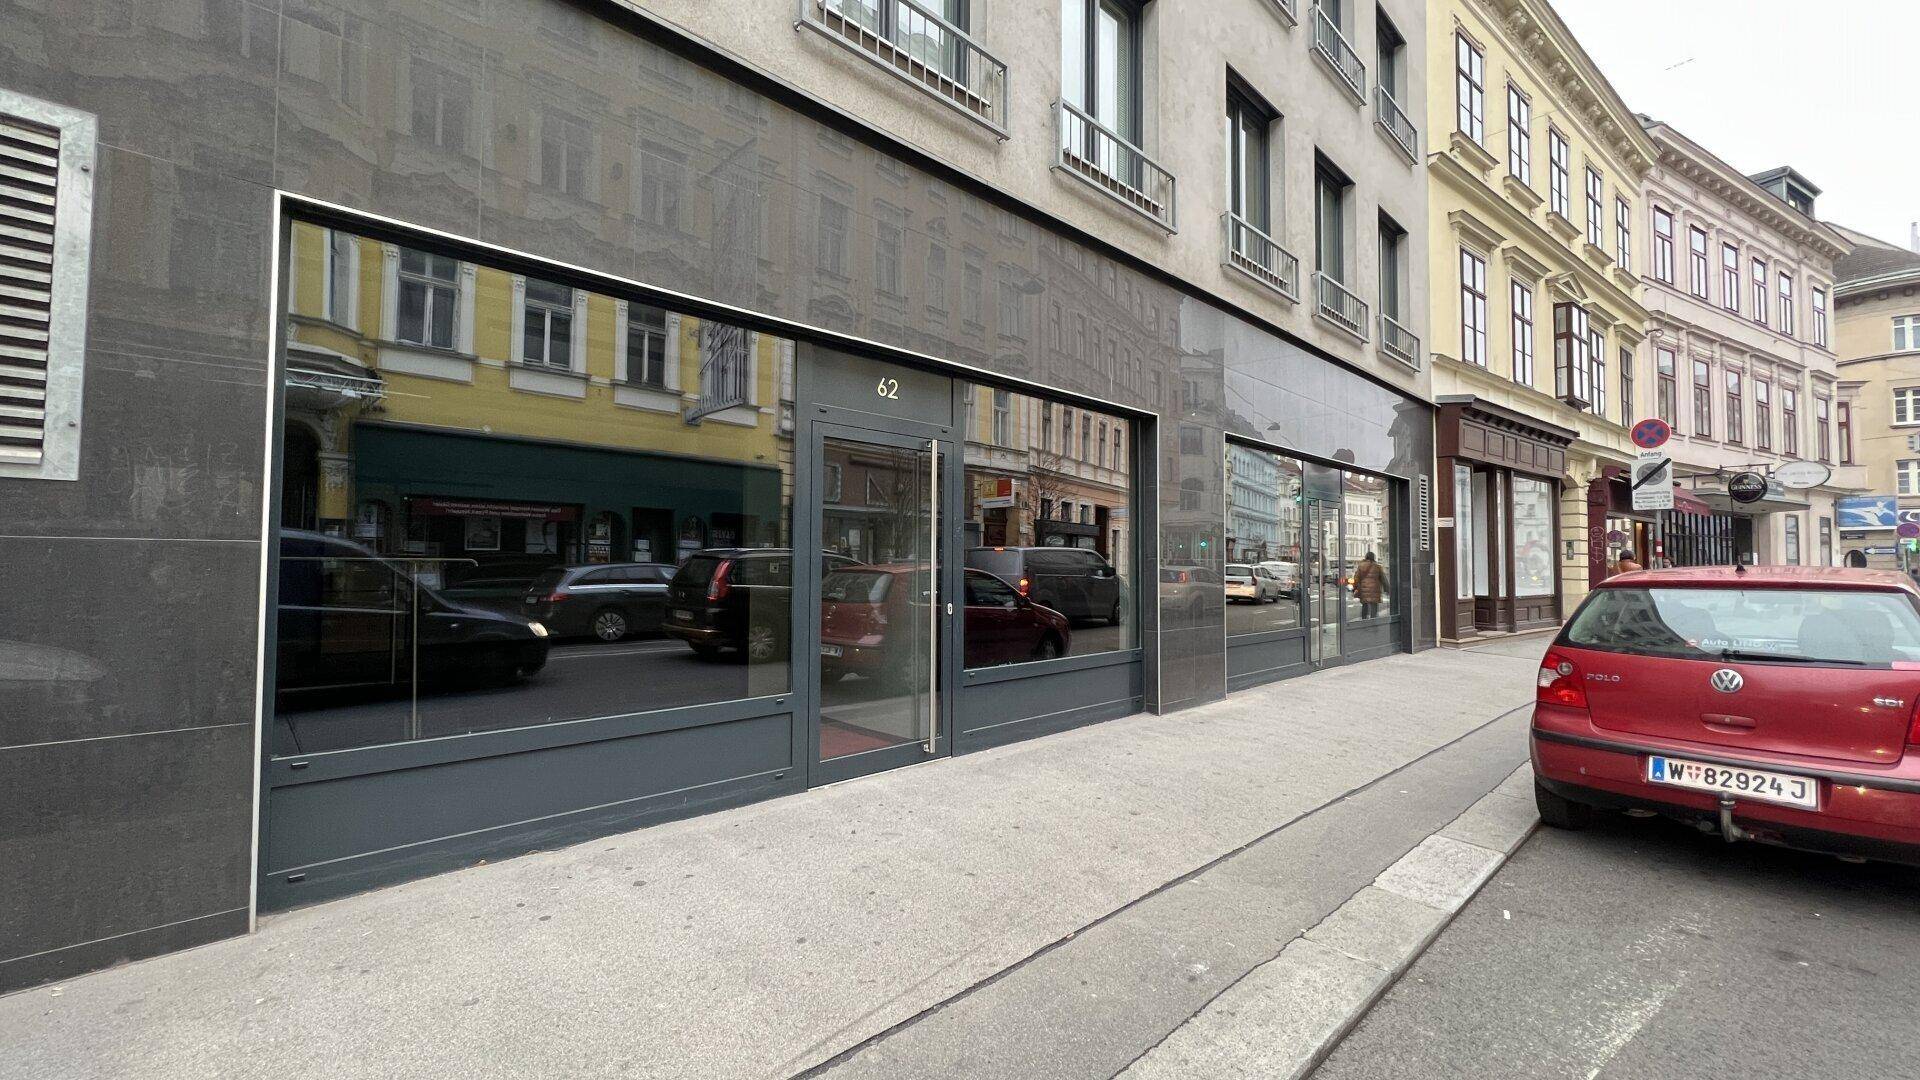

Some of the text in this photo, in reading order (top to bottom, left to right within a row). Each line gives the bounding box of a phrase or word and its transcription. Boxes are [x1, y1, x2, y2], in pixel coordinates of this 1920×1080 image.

[877, 377, 899, 400] 62
[1640, 451, 1662, 459] Anfang
[1702, 638, 1728, 647] Auto
[1586, 673, 1620, 682] POLO
[1872, 697, 1904, 708] SDI
[1668, 762, 1806, 799] W 82924 J
